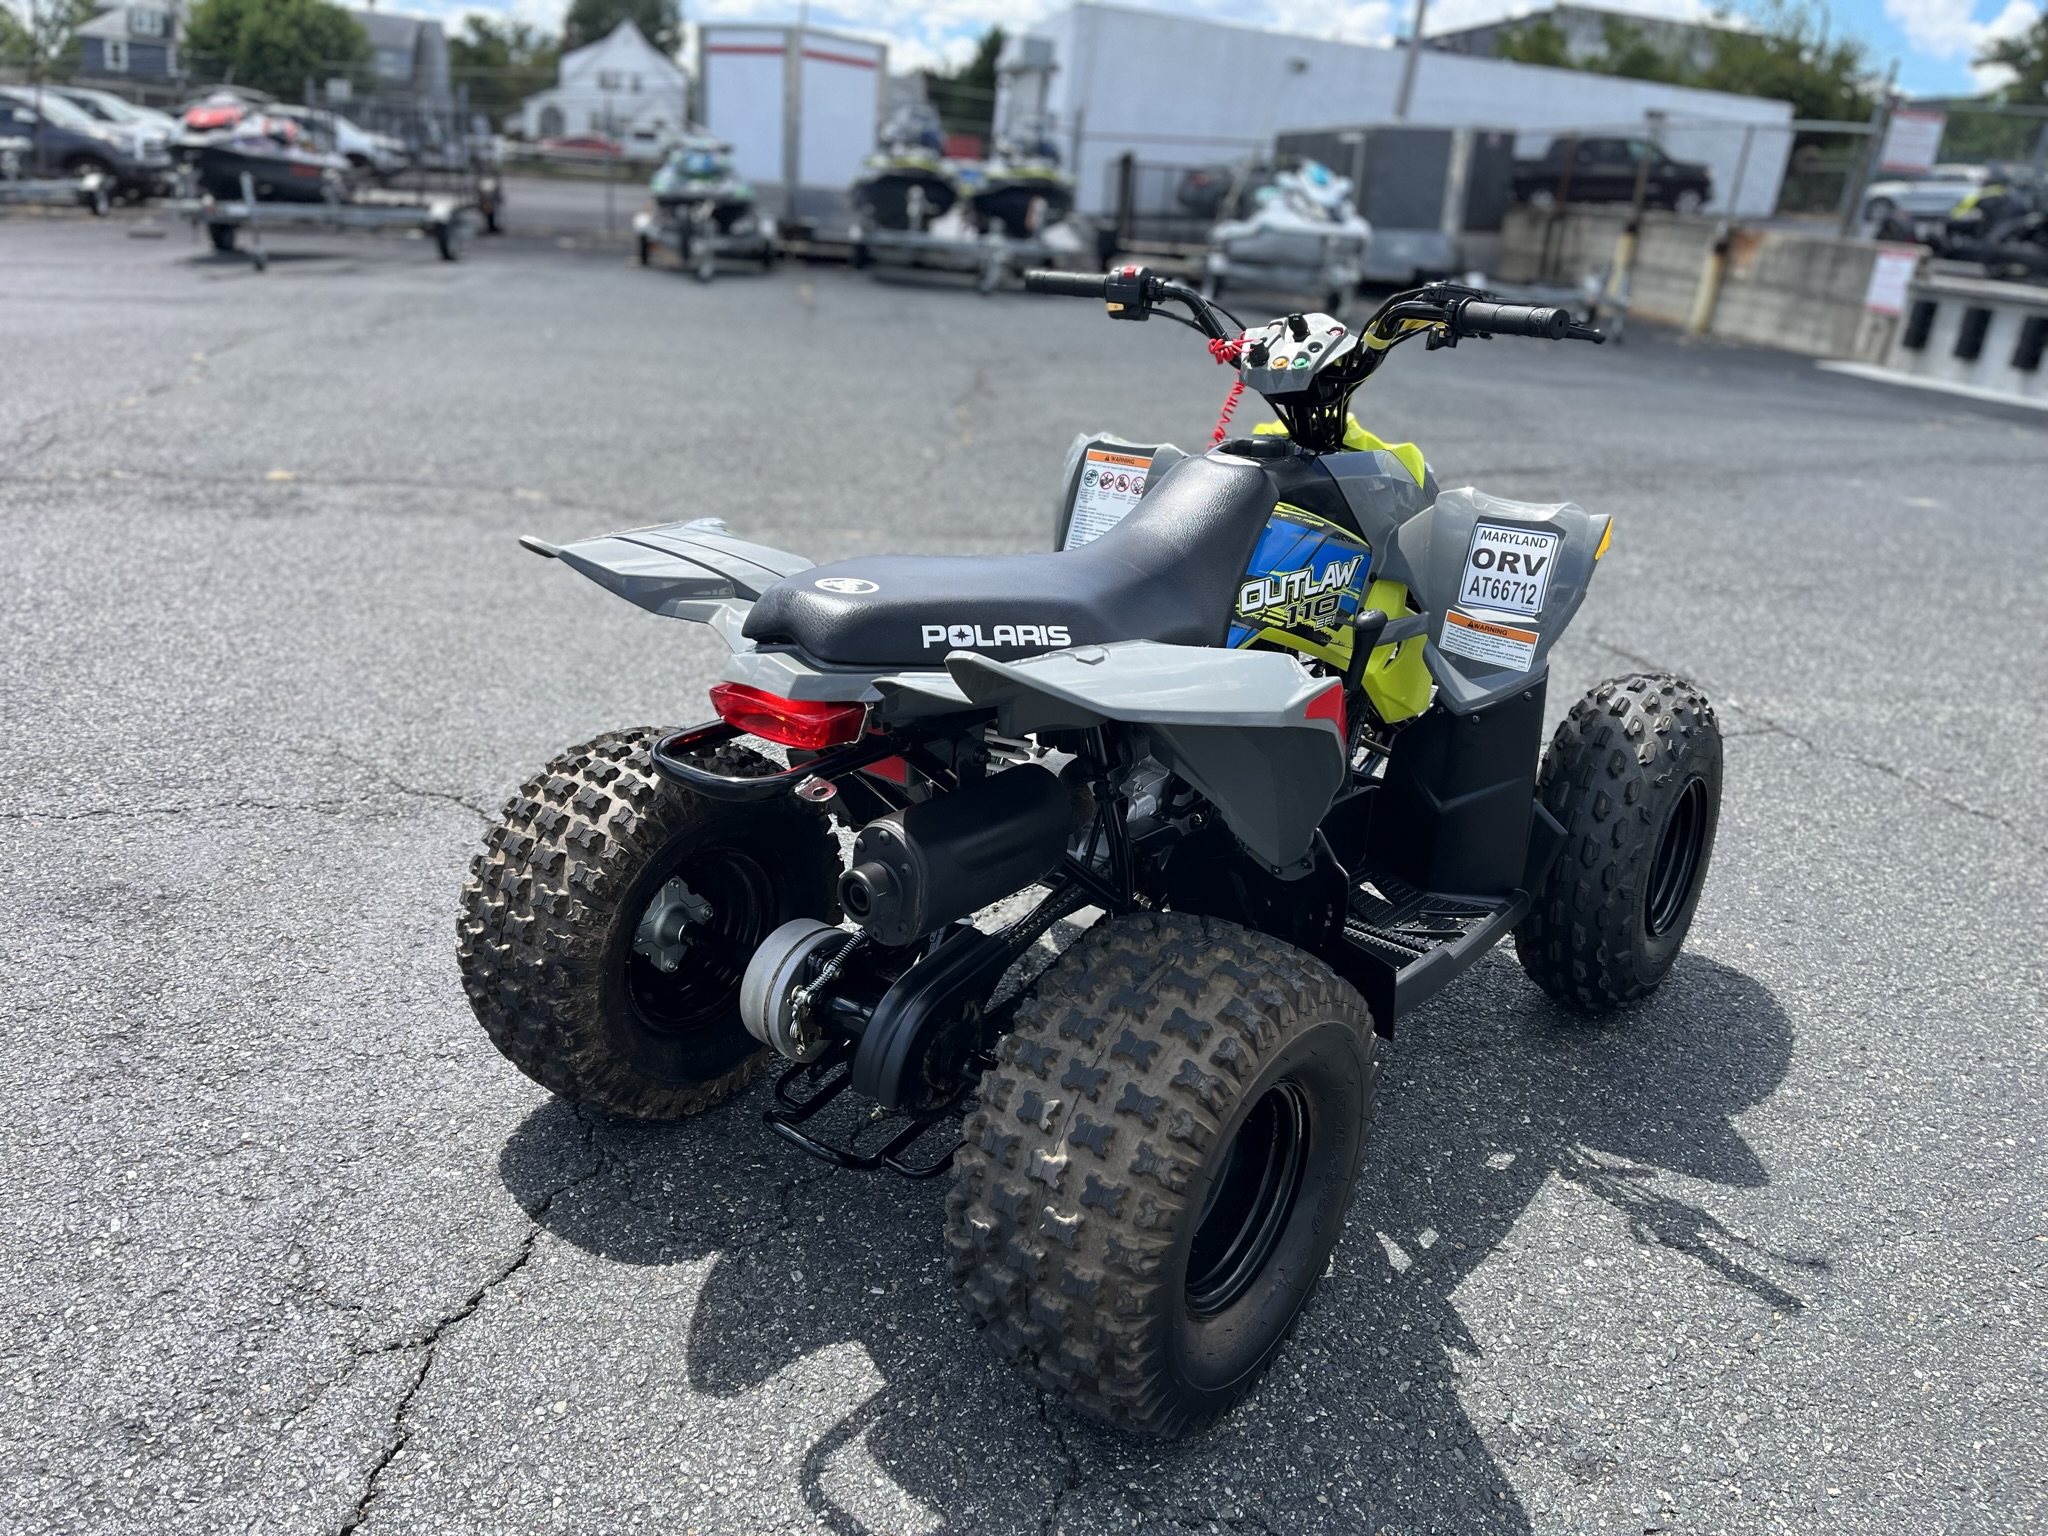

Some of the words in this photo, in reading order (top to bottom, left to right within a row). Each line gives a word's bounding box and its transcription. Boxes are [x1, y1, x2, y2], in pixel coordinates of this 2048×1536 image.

[1110, 456, 1136, 465] WARNING
[1480, 530, 1549, 549] MARYLAND
[1471, 548, 1548, 577] ORV
[1239, 556, 1363, 614] OUTLAW
[1468, 575, 1538, 605] AT66712
[1285, 594, 1340, 628] 110
[921, 624, 1072, 649] POLARIS
[1473, 622, 1508, 636] WARNING
